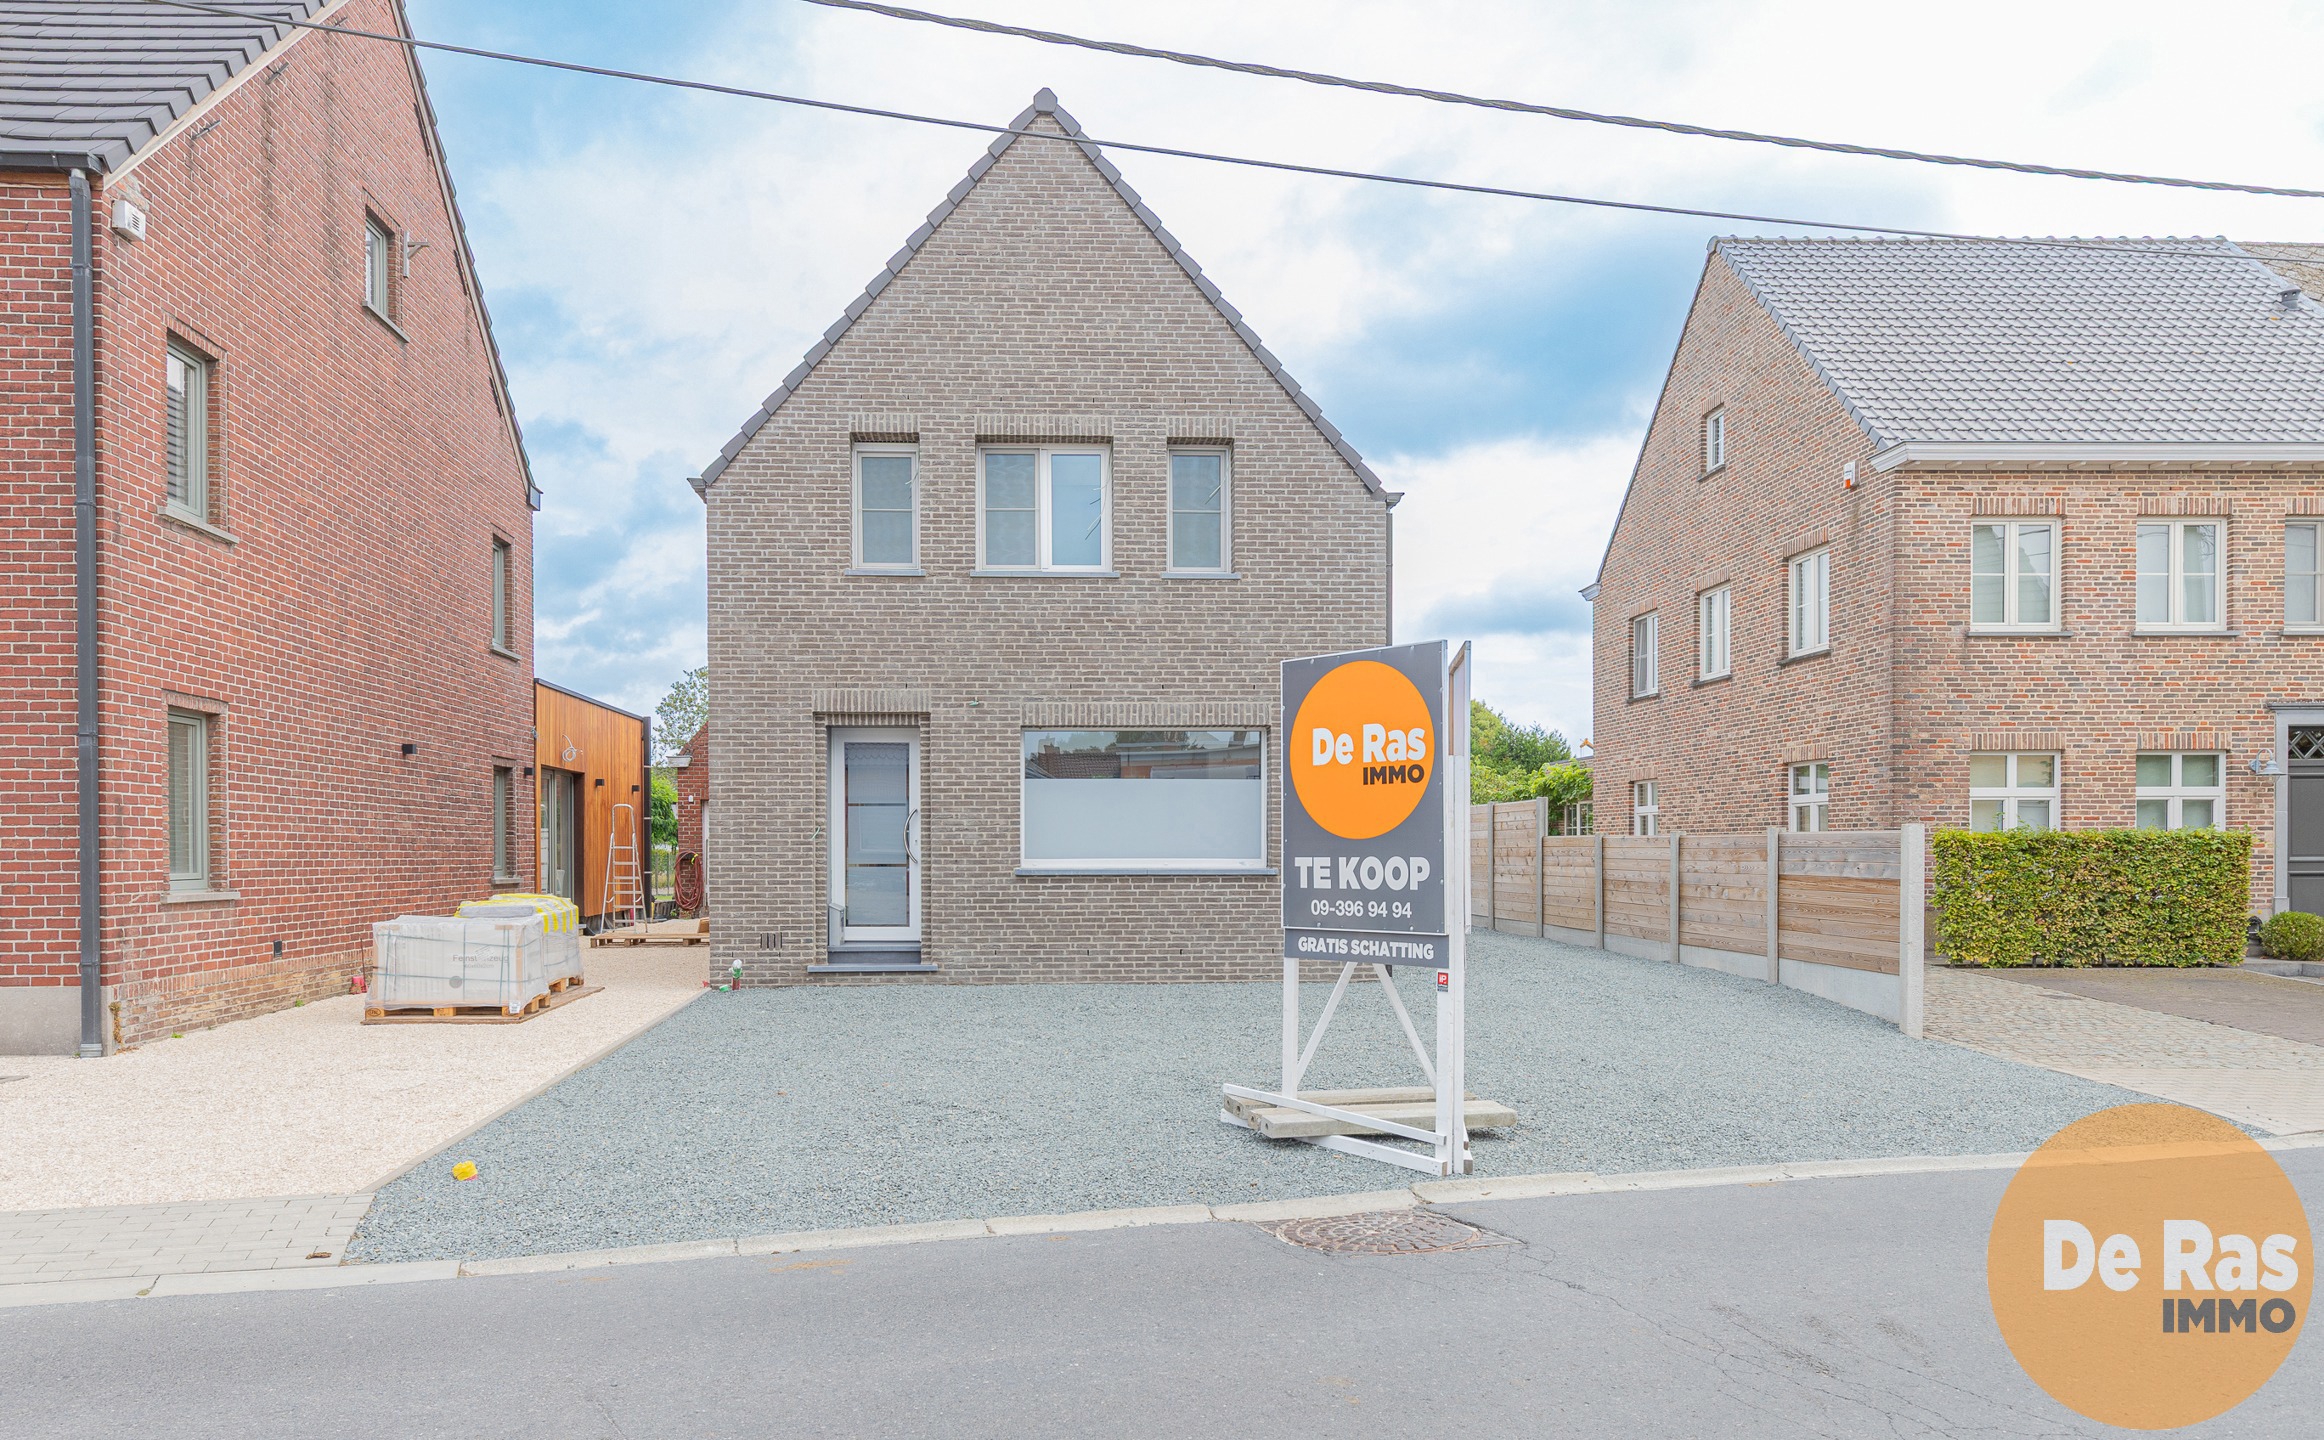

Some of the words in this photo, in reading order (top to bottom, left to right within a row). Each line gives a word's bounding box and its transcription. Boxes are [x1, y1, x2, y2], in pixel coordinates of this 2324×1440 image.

[1312, 727, 1354, 766] De
[1362, 723, 1426, 763] Ras
[1362, 764, 1425, 785] IMMO
[1294, 856, 1332, 889] TE
[1338, 855, 1430, 891] KOOP
[1310, 899, 1364, 917] 09-396
[1367, 900, 1388, 918] 94
[1391, 901, 1412, 919] 94
[1298, 936, 1348, 955] GRATIS
[1350, 939, 1434, 960] SCHATTING
